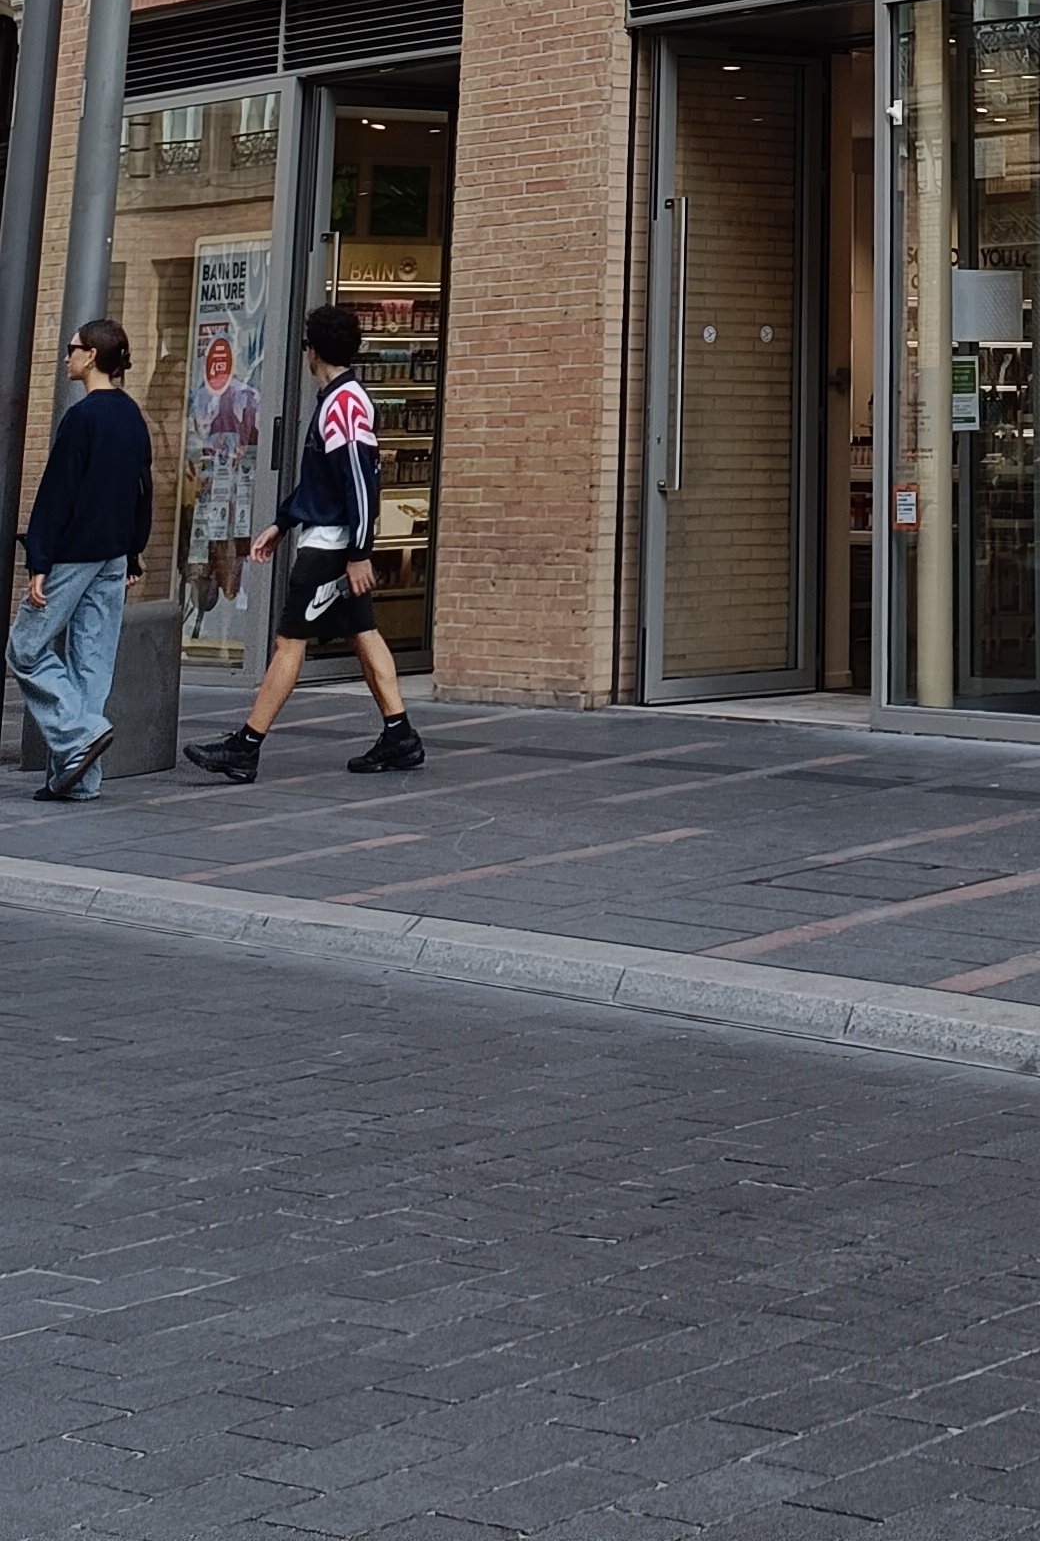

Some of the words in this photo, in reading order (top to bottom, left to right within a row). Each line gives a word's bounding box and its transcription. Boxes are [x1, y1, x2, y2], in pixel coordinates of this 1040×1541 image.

[202, 262, 230, 281] BAIN
[232, 261, 247, 279] DE
[350, 262, 395, 281] BAIN
[201, 282, 246, 302] NATURE
